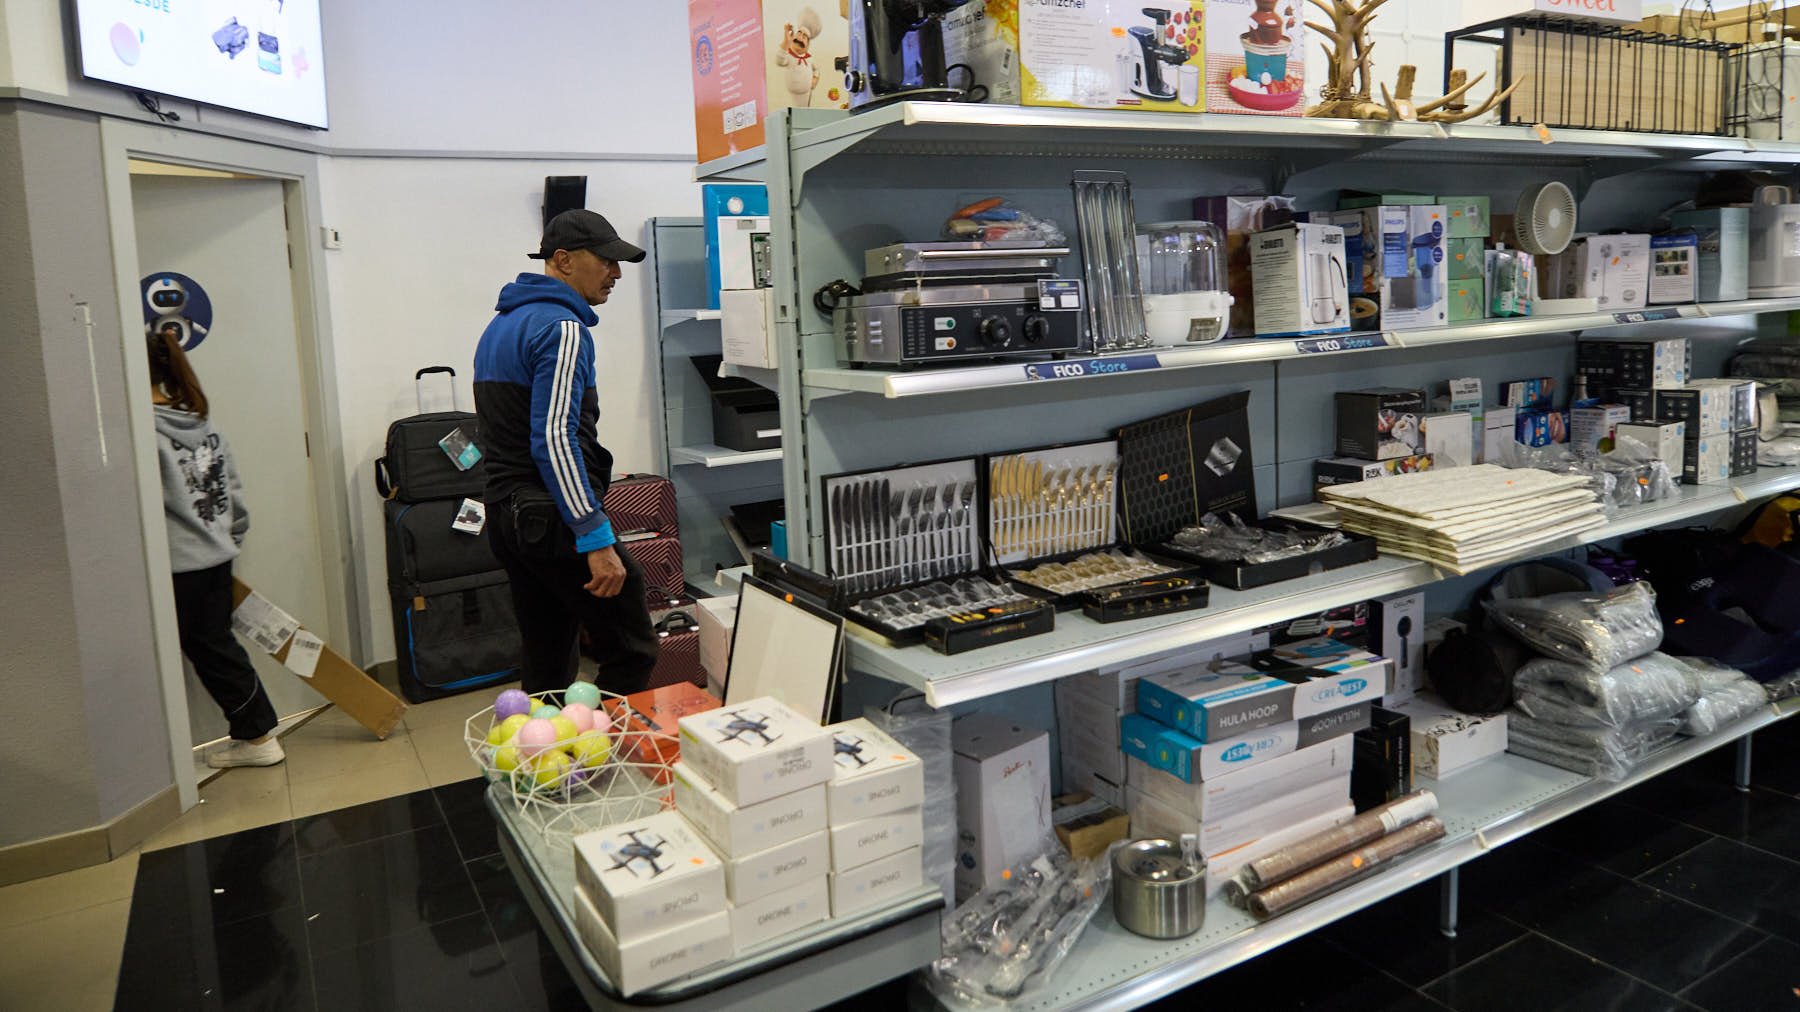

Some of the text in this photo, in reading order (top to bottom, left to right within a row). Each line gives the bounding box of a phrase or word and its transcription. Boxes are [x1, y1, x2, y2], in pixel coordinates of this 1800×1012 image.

[1316, 340, 1341, 353] FICO
[1052, 360, 1129, 378] FICO Store
[1219, 709, 1248, 729] HULA
[1248, 703, 1280, 721] HOOP
[1311, 708, 1362, 733] HULA HOOP
[868, 783, 901, 801] DRONE
[770, 808, 804, 827] DRONE
[857, 829, 889, 848] DRONE
[773, 855, 808, 876] DRONE
[869, 870, 901, 889] DRONE
[757, 905, 792, 926] DRONE
[650, 949, 688, 969] DRONE
